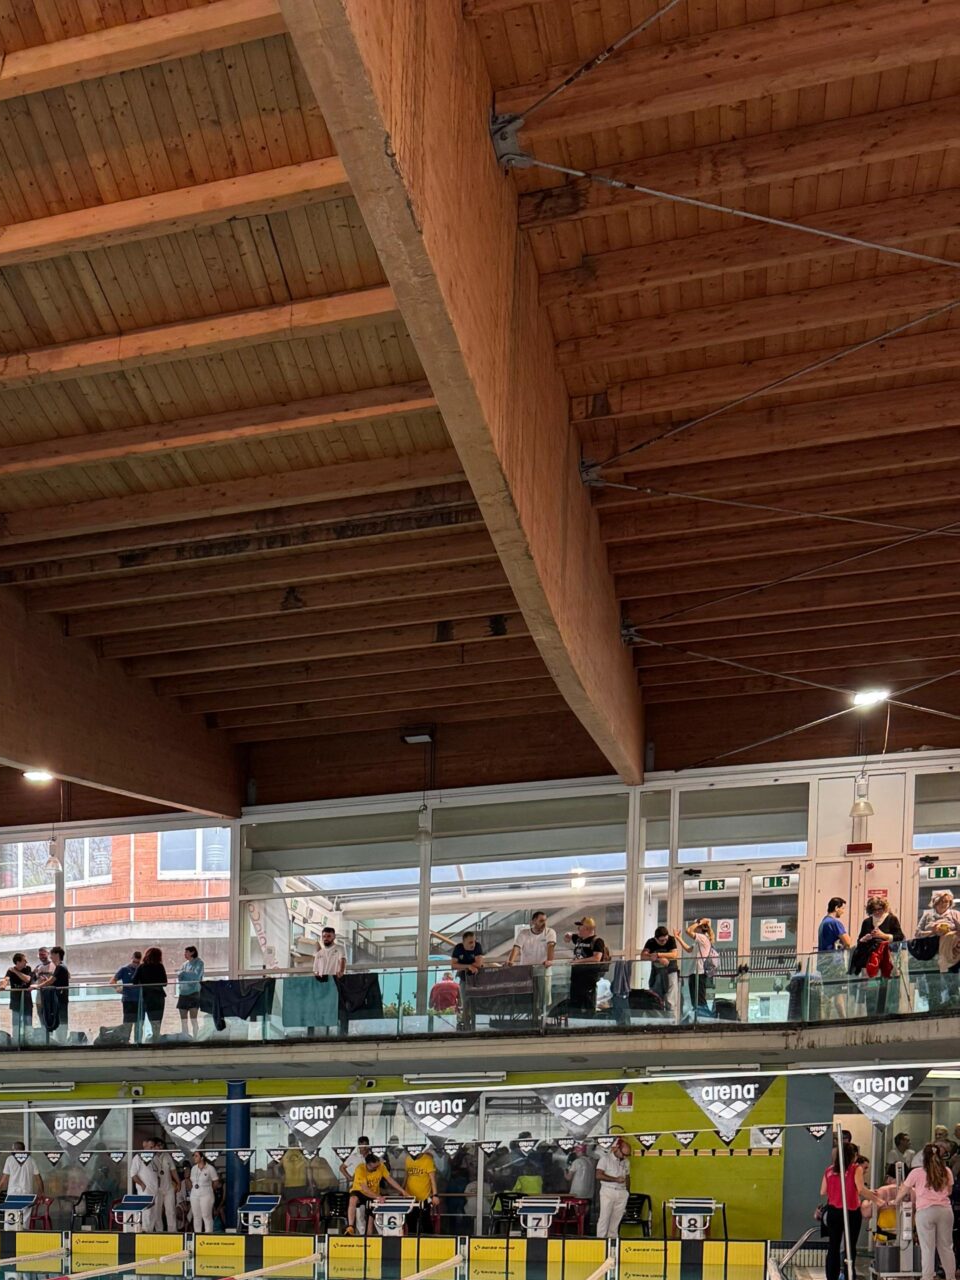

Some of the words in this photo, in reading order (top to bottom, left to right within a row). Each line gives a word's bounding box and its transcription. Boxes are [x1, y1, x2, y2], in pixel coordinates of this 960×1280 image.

[701, 1084, 757, 1101] arena
[853, 1076, 911, 1094] arena
[414, 1099, 465, 1115] arena
[554, 1091, 607, 1108] arena
[167, 1111, 212, 1126] arena
[289, 1105, 336, 1121] arena
[54, 1115, 96, 1130] arena
[7, 1212, 15, 1225] 3
[126, 1214, 134, 1227] 4
[253, 1215, 261, 1228] 5
[387, 1216, 396, 1229] 6
[532, 1218, 542, 1231] 7
[688, 1218, 697, 1232] 8
